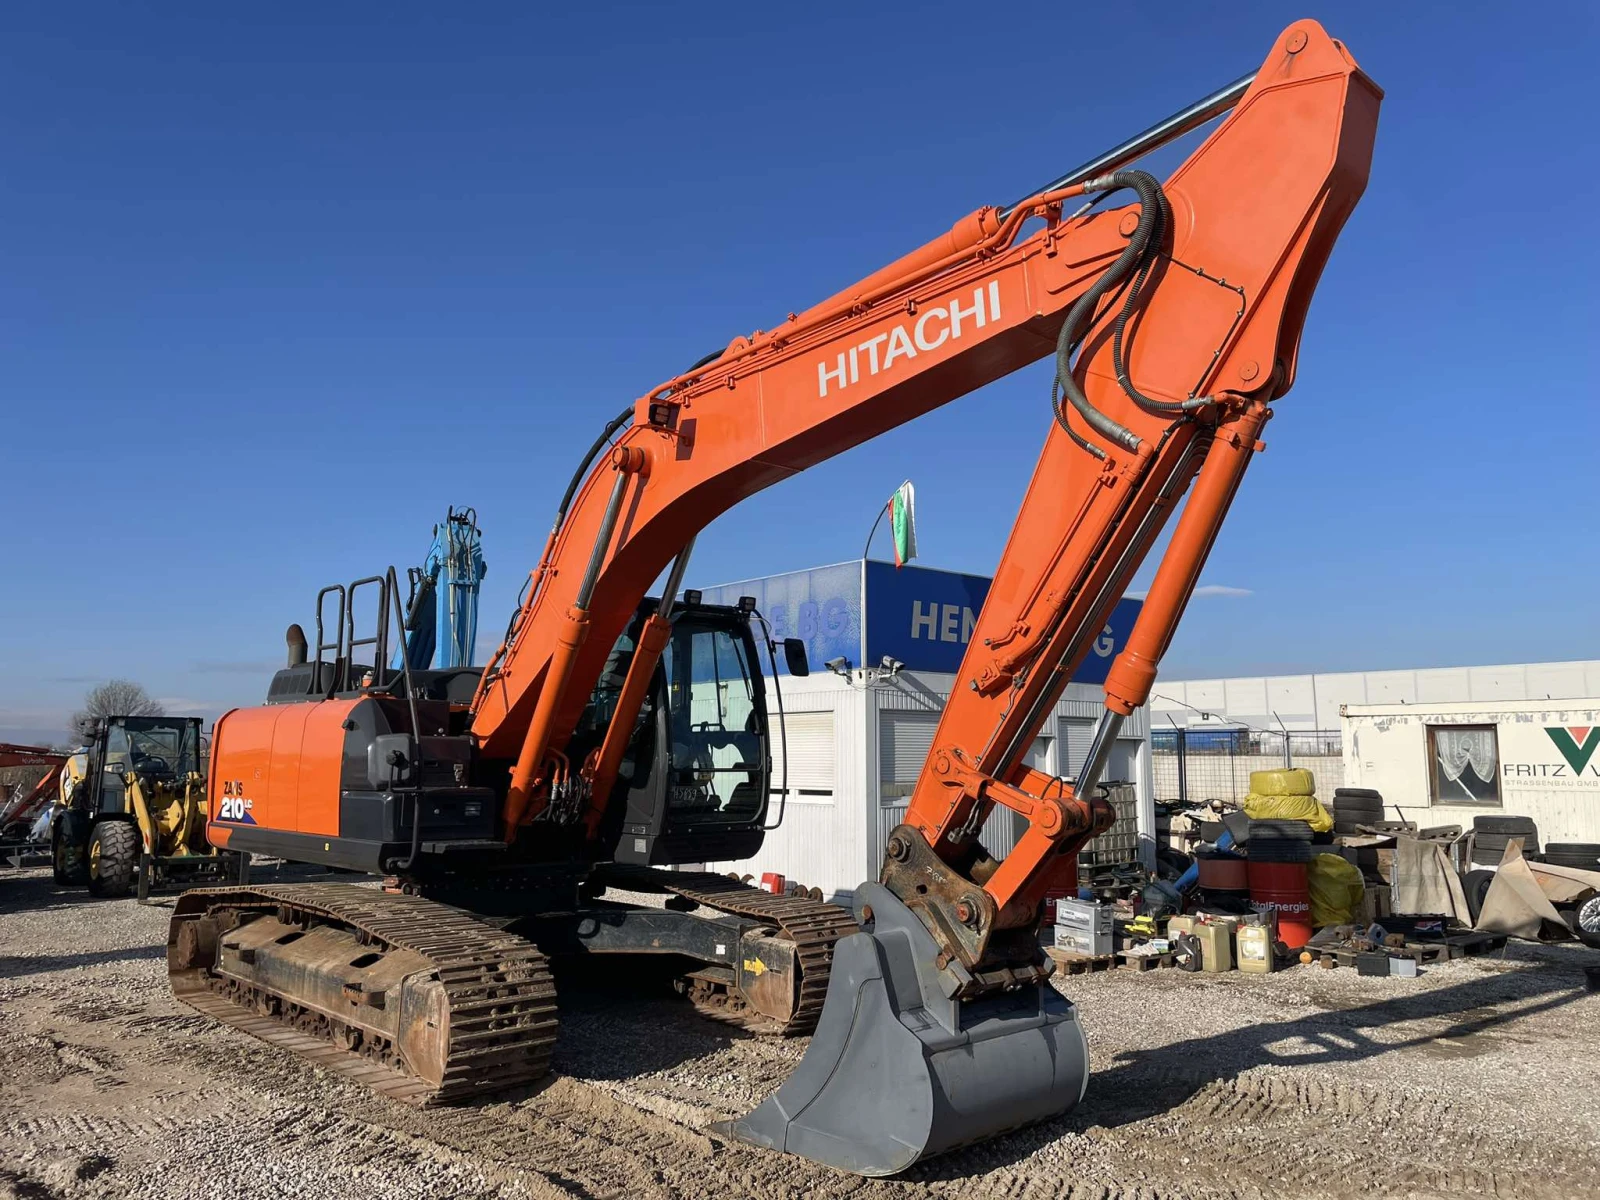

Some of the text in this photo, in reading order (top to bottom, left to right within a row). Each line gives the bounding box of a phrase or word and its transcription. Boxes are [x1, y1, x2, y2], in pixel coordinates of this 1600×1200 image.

[818, 280, 1001, 398] HITACHI
[799, 598, 848, 640] BG
[1503, 764, 1567, 777] FRITZ
[1504, 780, 1574, 788] STRASSENBAU
[221, 797, 244, 819] 210
